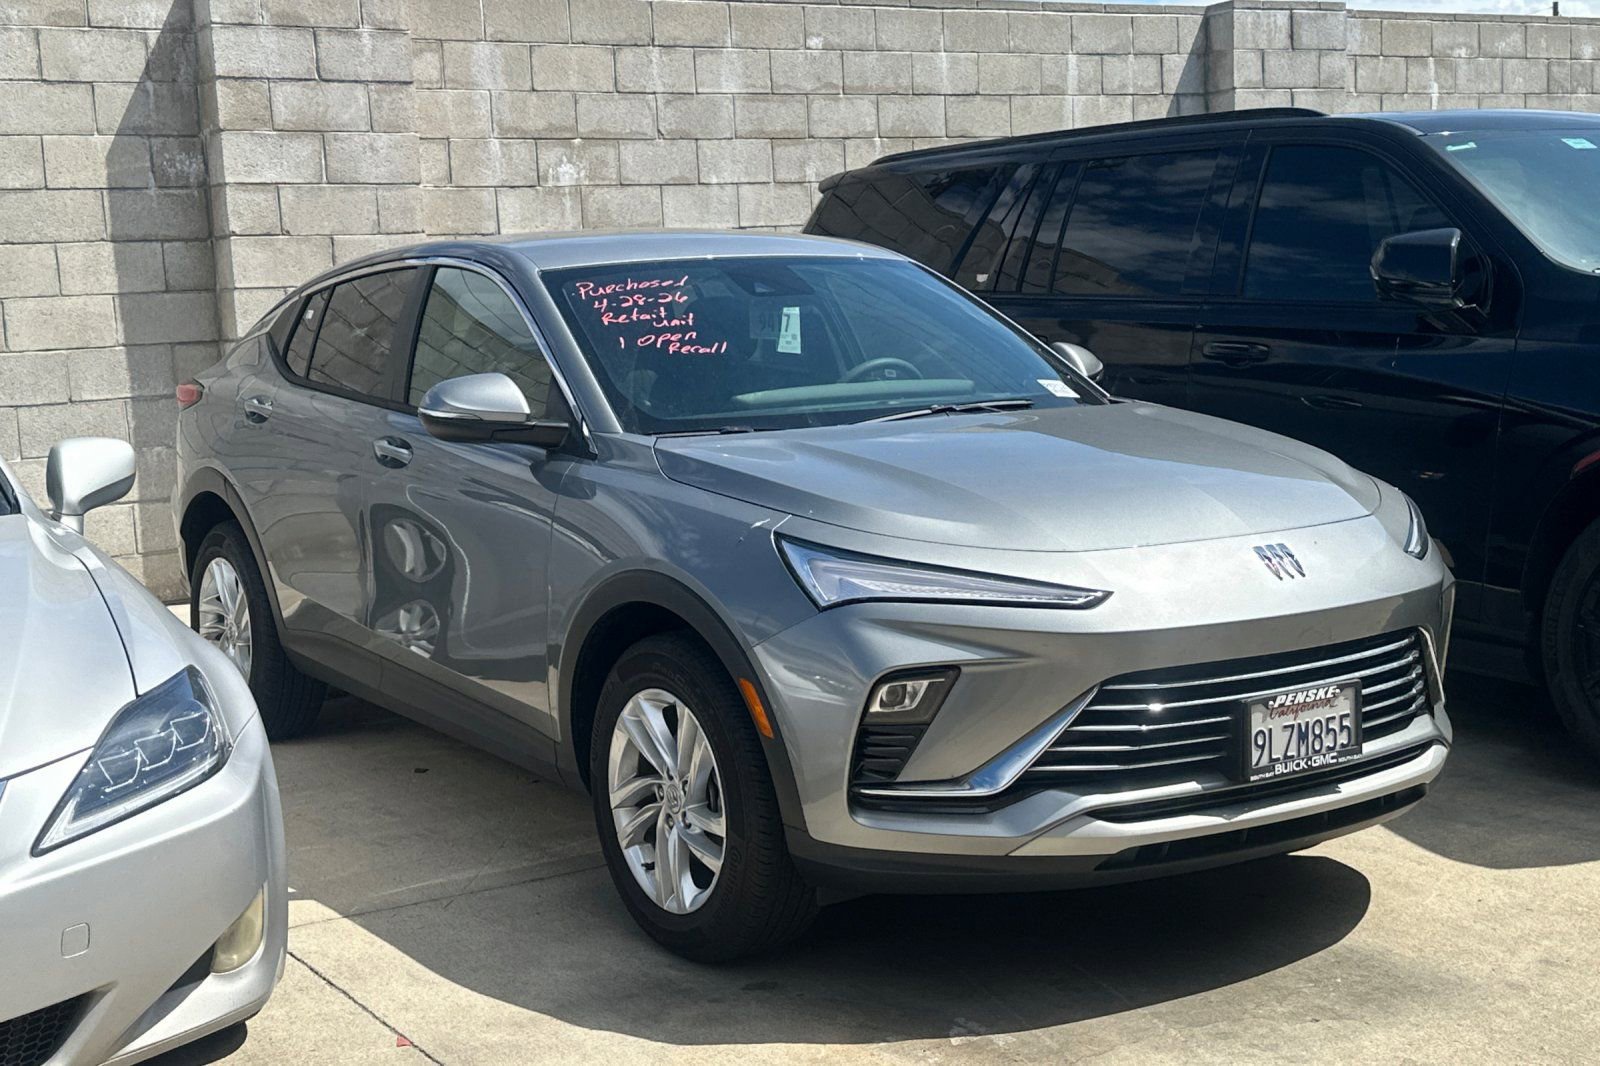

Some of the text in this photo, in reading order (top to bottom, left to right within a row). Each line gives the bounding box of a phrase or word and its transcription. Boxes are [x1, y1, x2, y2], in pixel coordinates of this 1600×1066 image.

[576, 275, 689, 300] Purchased
[594, 291, 689, 313] 4-28-26
[601, 306, 668, 326] Retail
[668, 341, 728, 355] Recall
[1273, 685, 1338, 708] PENSKE
[1253, 712, 1352, 768] 9LZM855
